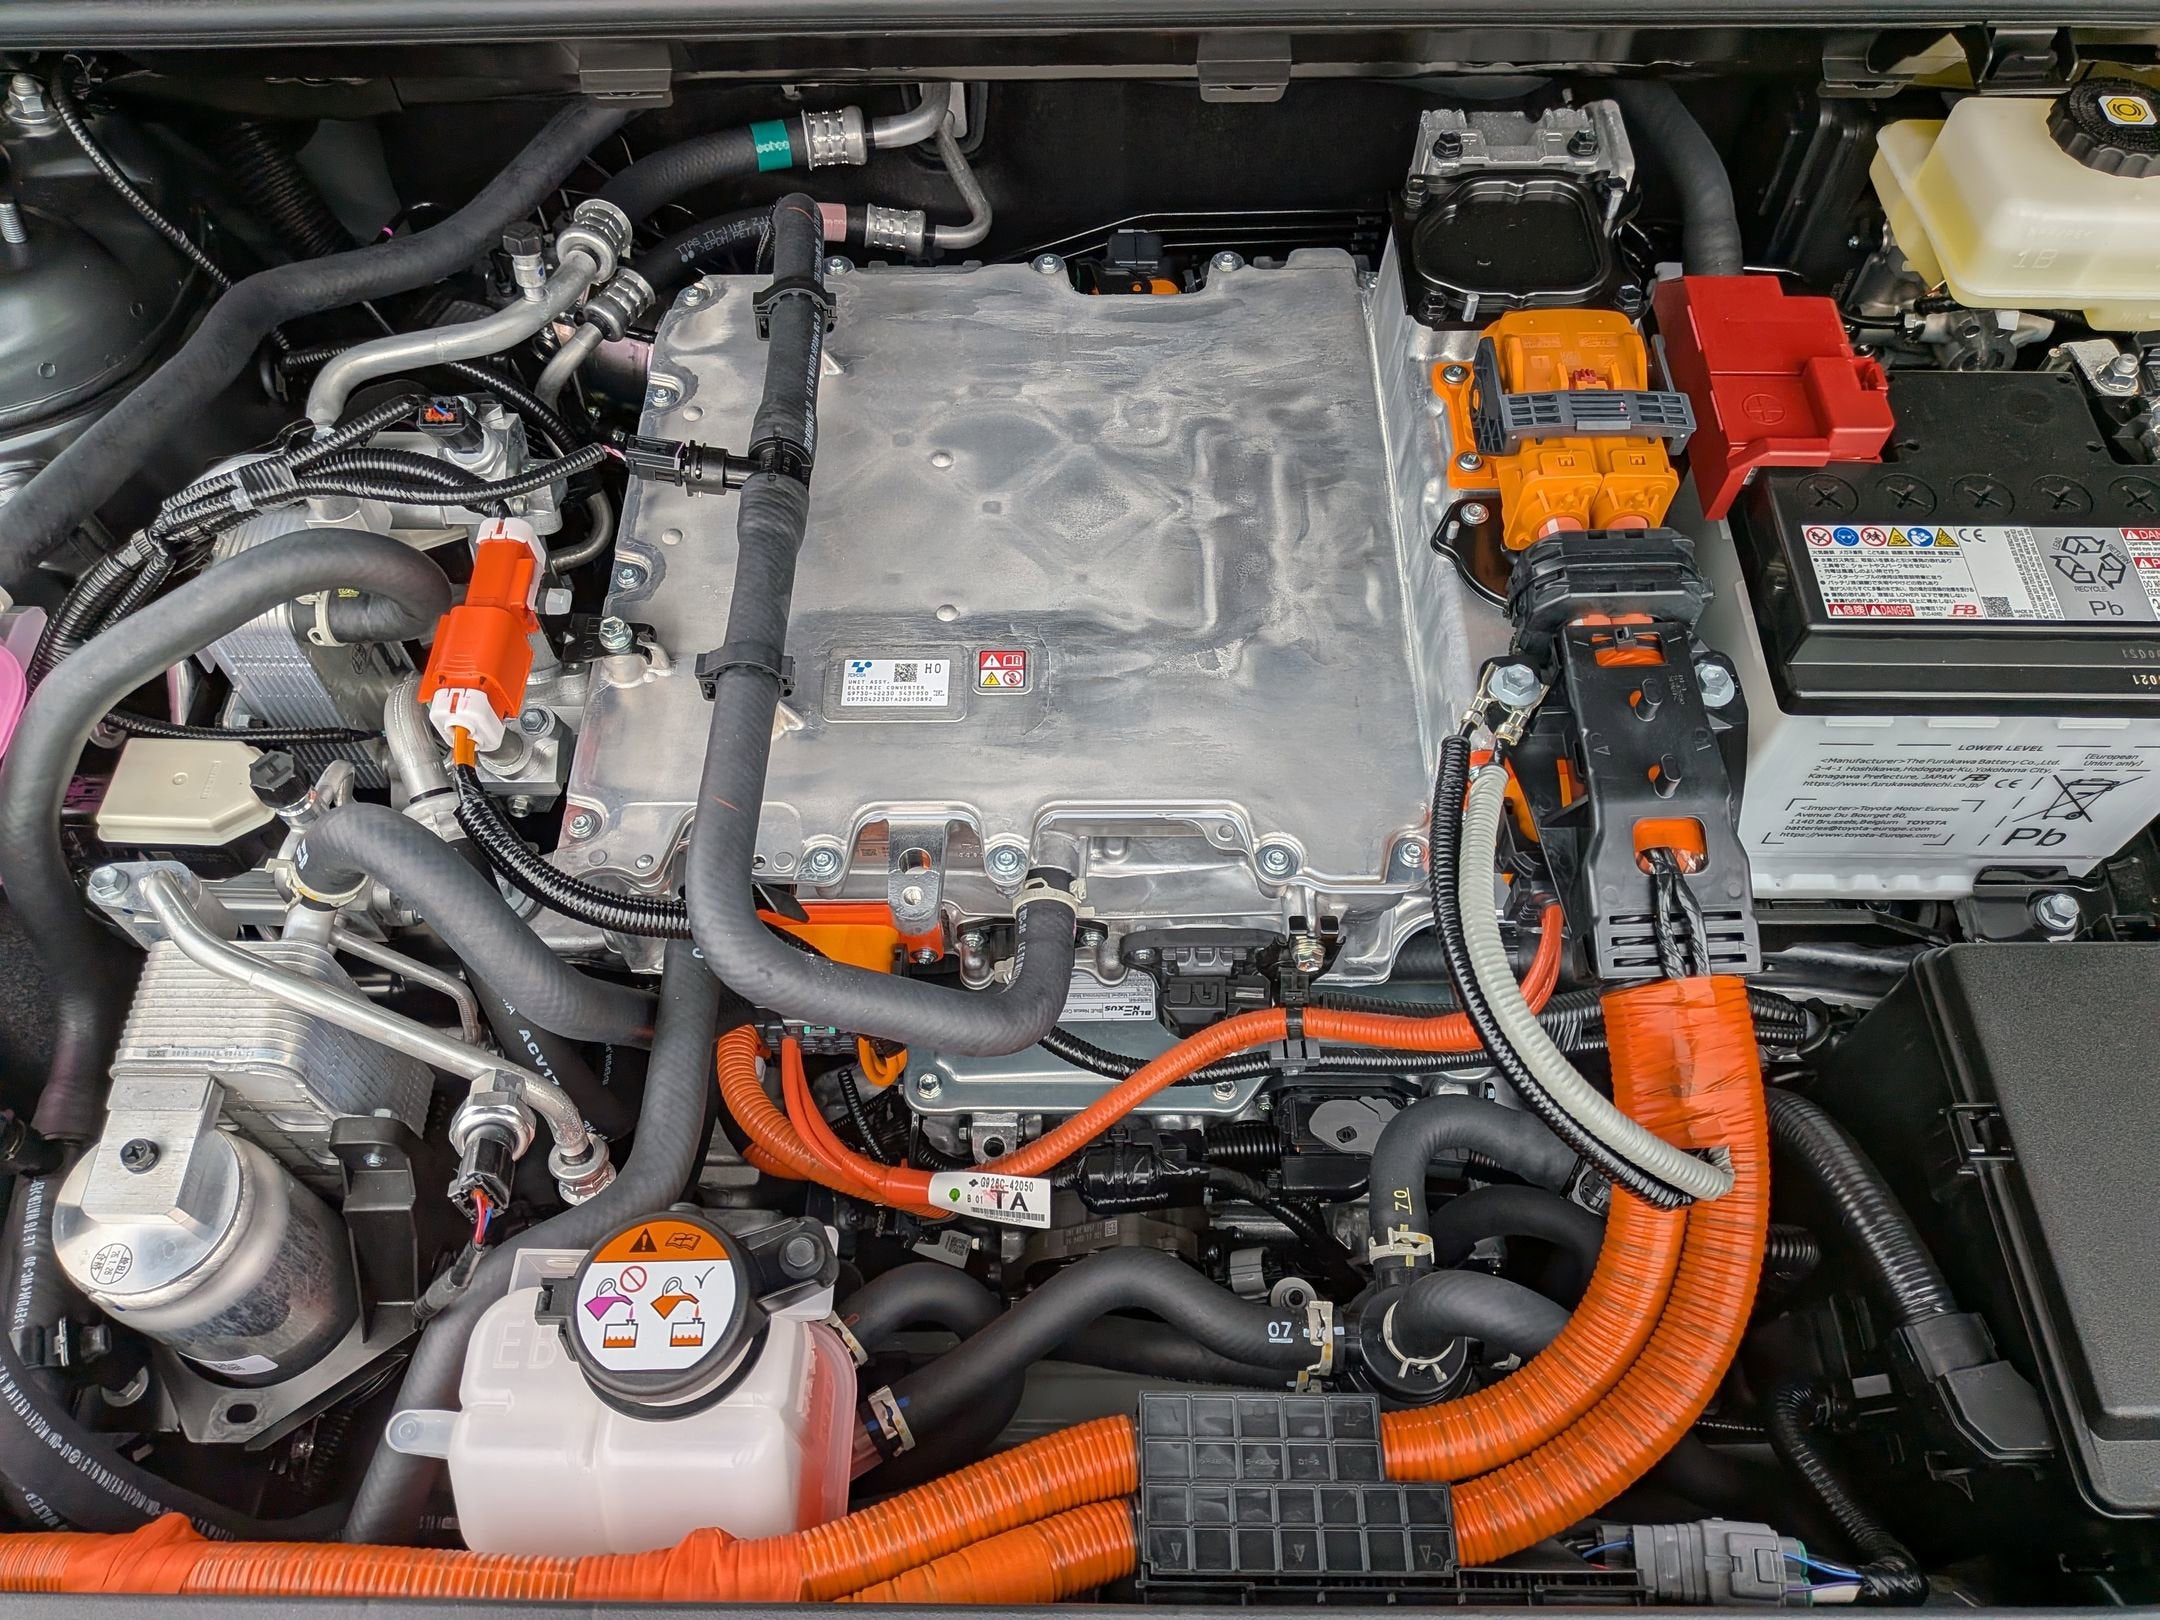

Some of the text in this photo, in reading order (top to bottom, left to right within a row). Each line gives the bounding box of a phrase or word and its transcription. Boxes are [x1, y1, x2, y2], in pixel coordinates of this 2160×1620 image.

[1844, 605, 1866, 615] 危険
[1880, 605, 1913, 616] DANGER
[2089, 600, 2124, 616] Pb
[2132, 675, 2160, 685] 021
[2001, 828, 2067, 846] Pb
[990, 1189, 1029, 1212] TA
[24, 1233, 36, 1247] LE
[1267, 1321, 1293, 1338] 07
